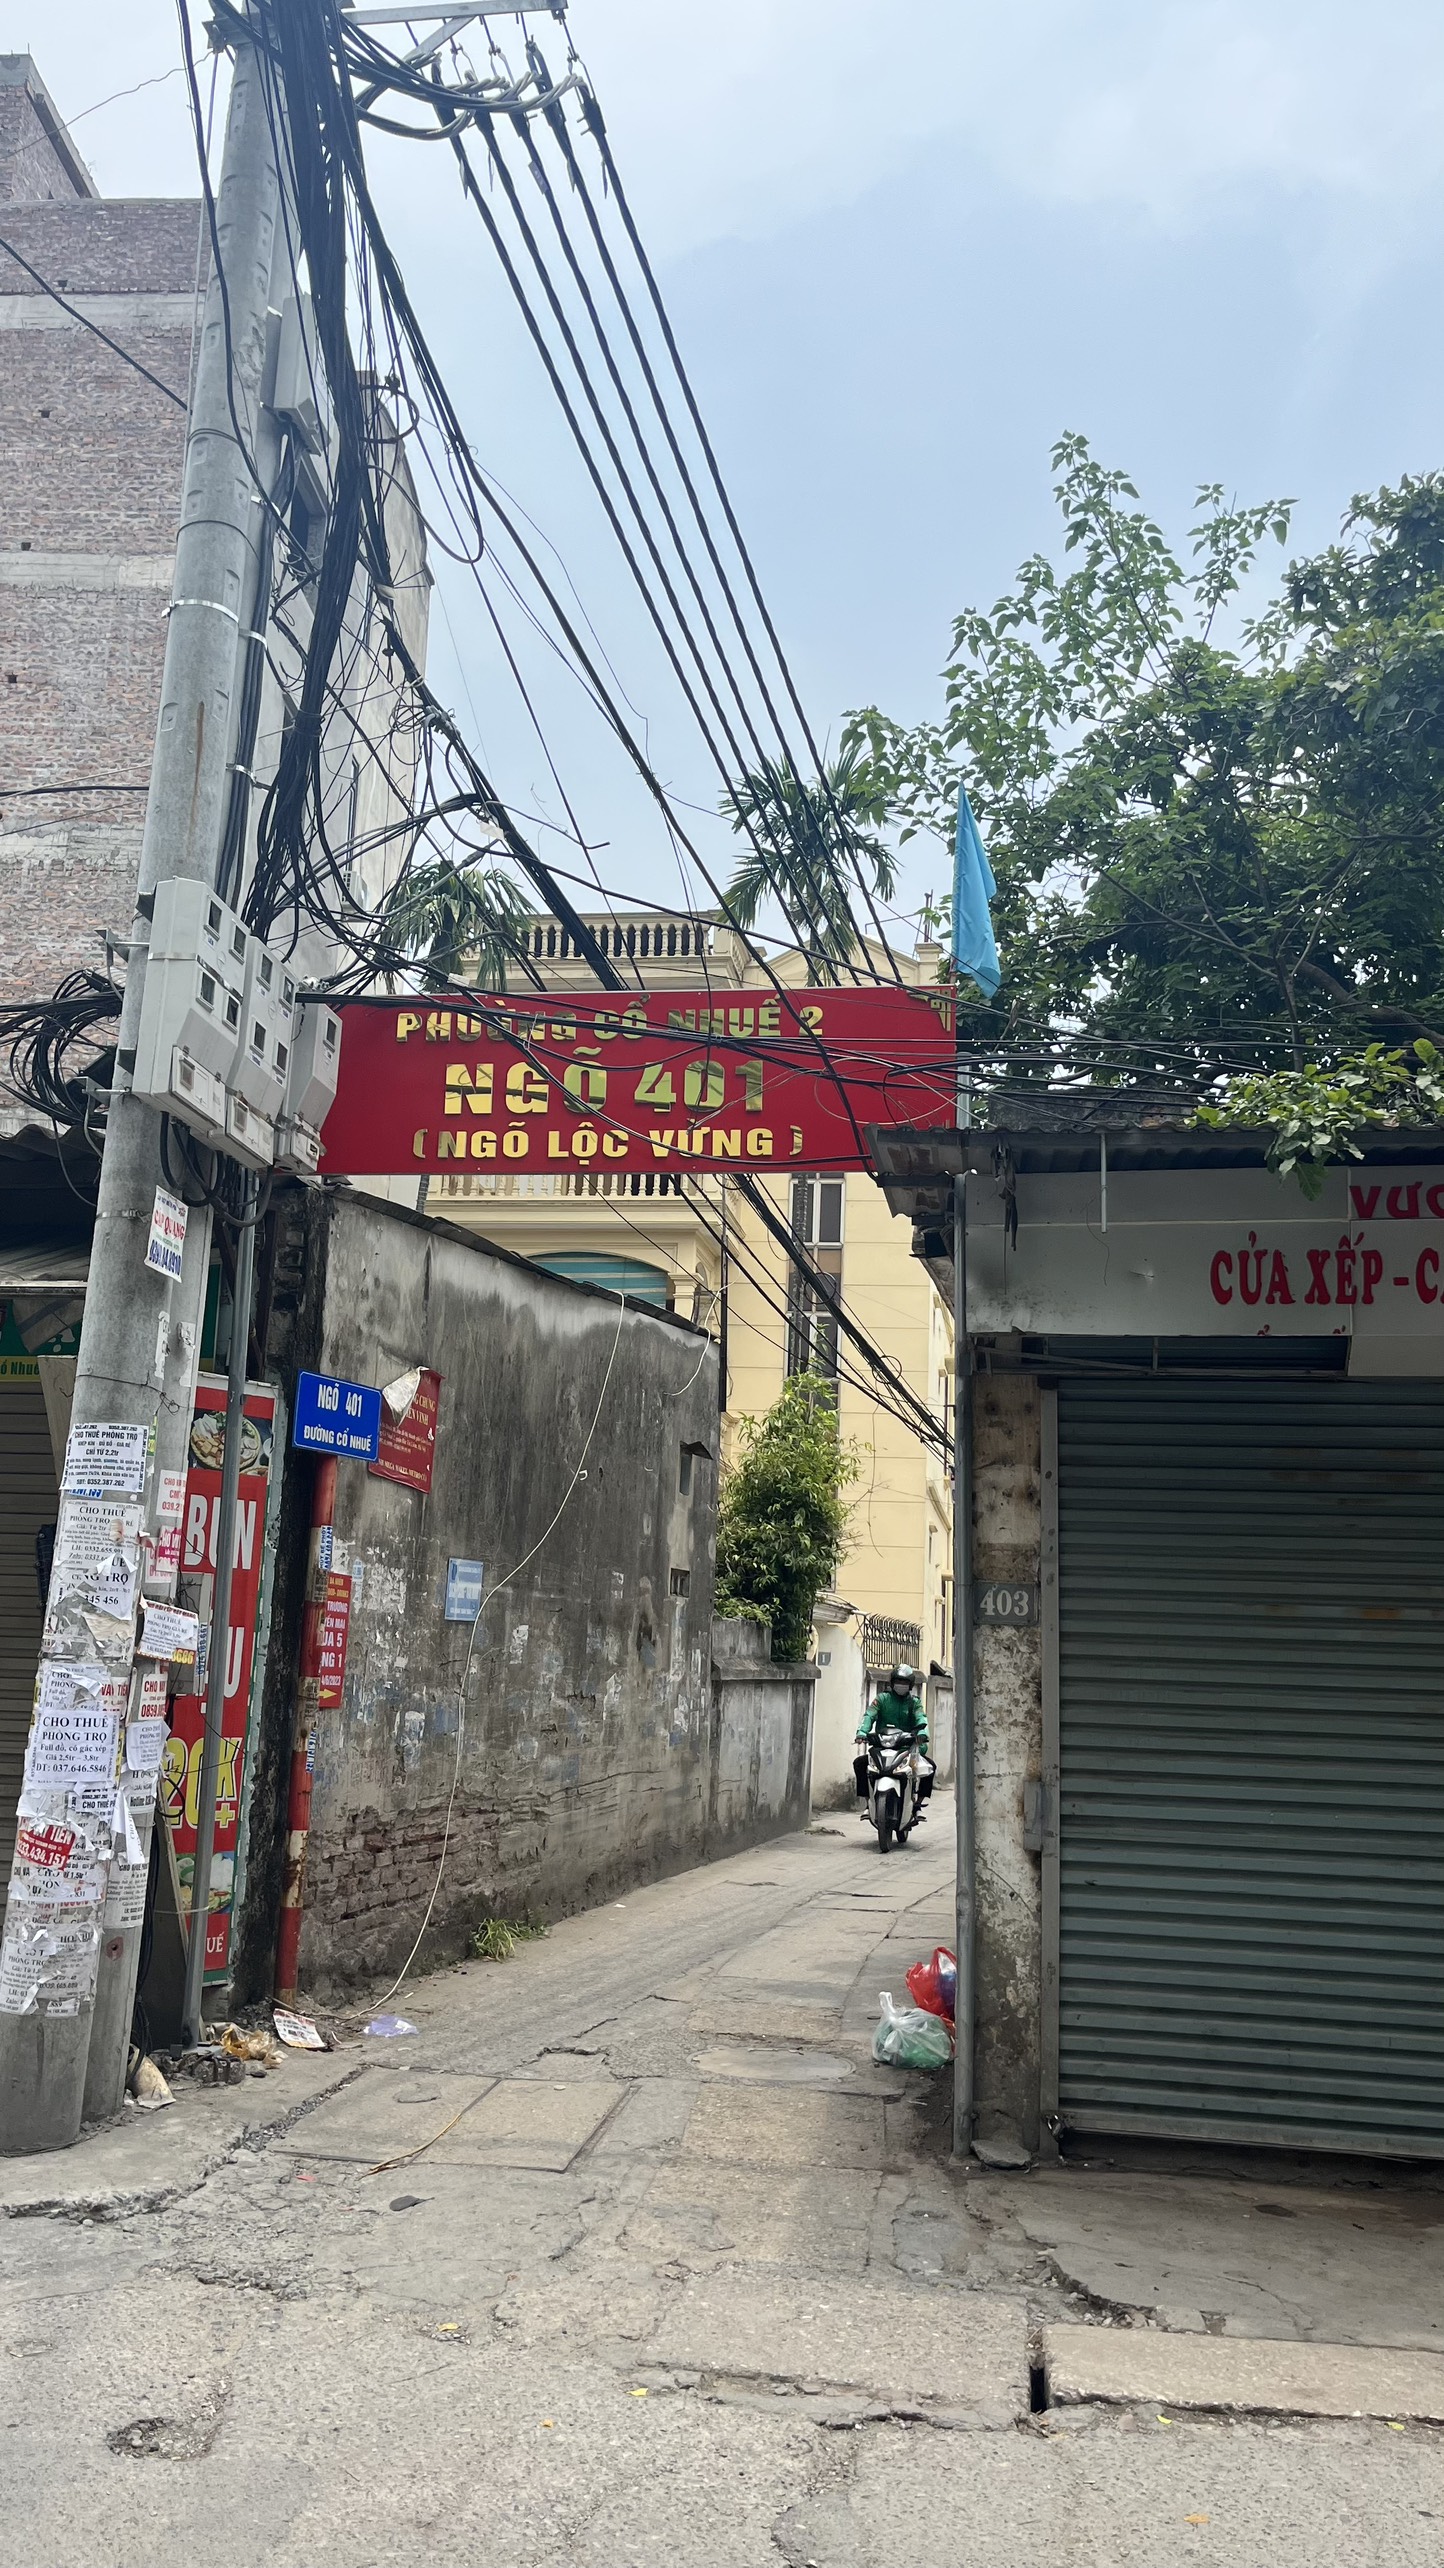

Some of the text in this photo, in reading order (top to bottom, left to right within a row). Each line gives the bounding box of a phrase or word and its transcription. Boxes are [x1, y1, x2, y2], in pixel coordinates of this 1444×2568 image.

[799, 1006, 823, 1037] 2
[444, 1047, 764, 1114] NGÕ 401
[548, 1122, 630, 1165] LỘC
[1211, 1231, 1295, 1304] CỬA
[317, 1384, 363, 1418] NGÕ 401
[101, 1429, 125, 1440] PHÒNG
[303, 1424, 335, 1444] ĐƯỜNG
[336, 1427, 350, 1447] CỔ
[349, 1434, 373, 1452] NHUẾ
[80, 1506, 127, 1517] CHO THUÊ
[103, 1596, 119, 1605] 456
[980, 1589, 1029, 1617] 403
[336, 1632, 343, 1648] 5
[338, 1653, 343, 1668] 1
[43, 1715, 108, 1728] CHO THUÊ
[42, 1729, 107, 1744] PHÒNG TRỌ
[40, 1743, 53, 1751] Full
[68, 1743, 78, 1751] có
[80, 1743, 93, 1753] gác
[52, 1763, 107, 1773] 037.646.5846
